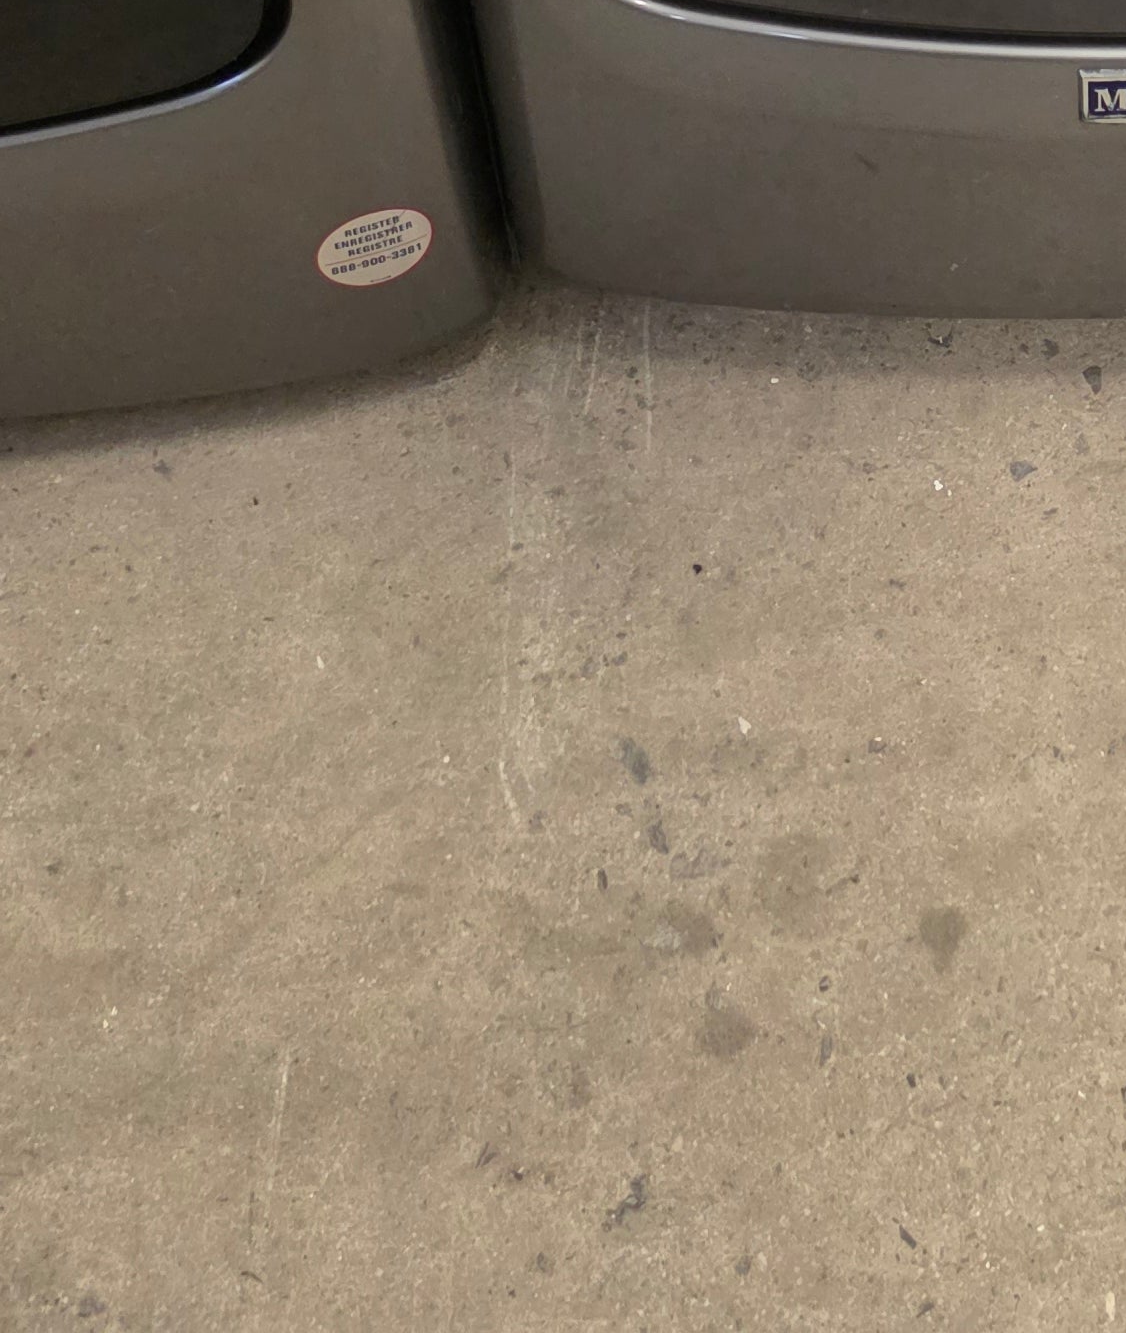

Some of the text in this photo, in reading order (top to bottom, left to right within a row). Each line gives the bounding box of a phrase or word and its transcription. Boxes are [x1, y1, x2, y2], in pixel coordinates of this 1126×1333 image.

[334, 221, 413, 250] ENREGISTRER
[344, 215, 400, 238] REGISTER
[347, 234, 404, 257] REGISTRE
